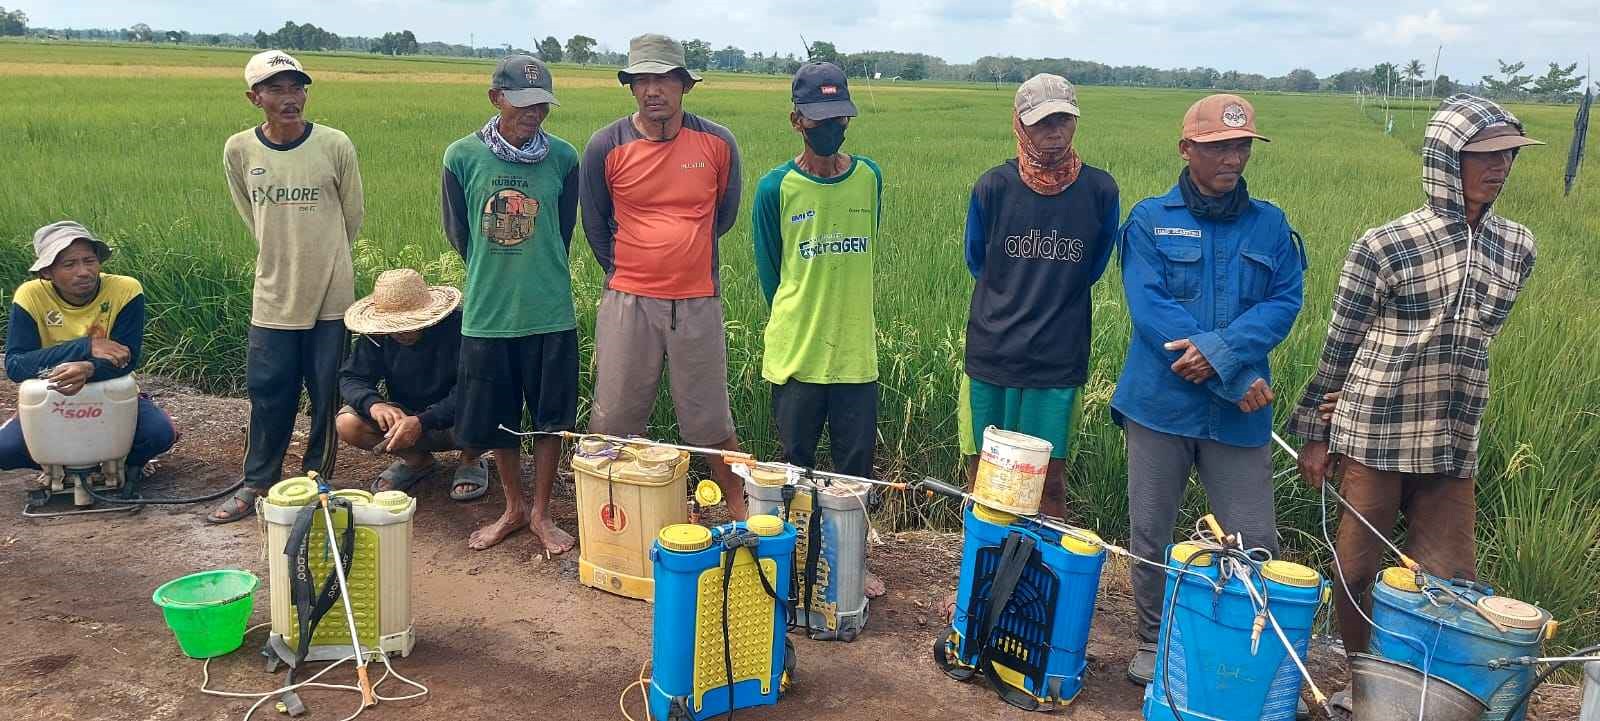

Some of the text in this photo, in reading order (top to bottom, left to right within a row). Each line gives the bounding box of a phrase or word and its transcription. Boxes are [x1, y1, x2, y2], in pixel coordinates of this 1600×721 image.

[491, 178, 529, 188] KUBOTA
[1004, 228, 1084, 262] adidas
[64, 406, 103, 419] solo
